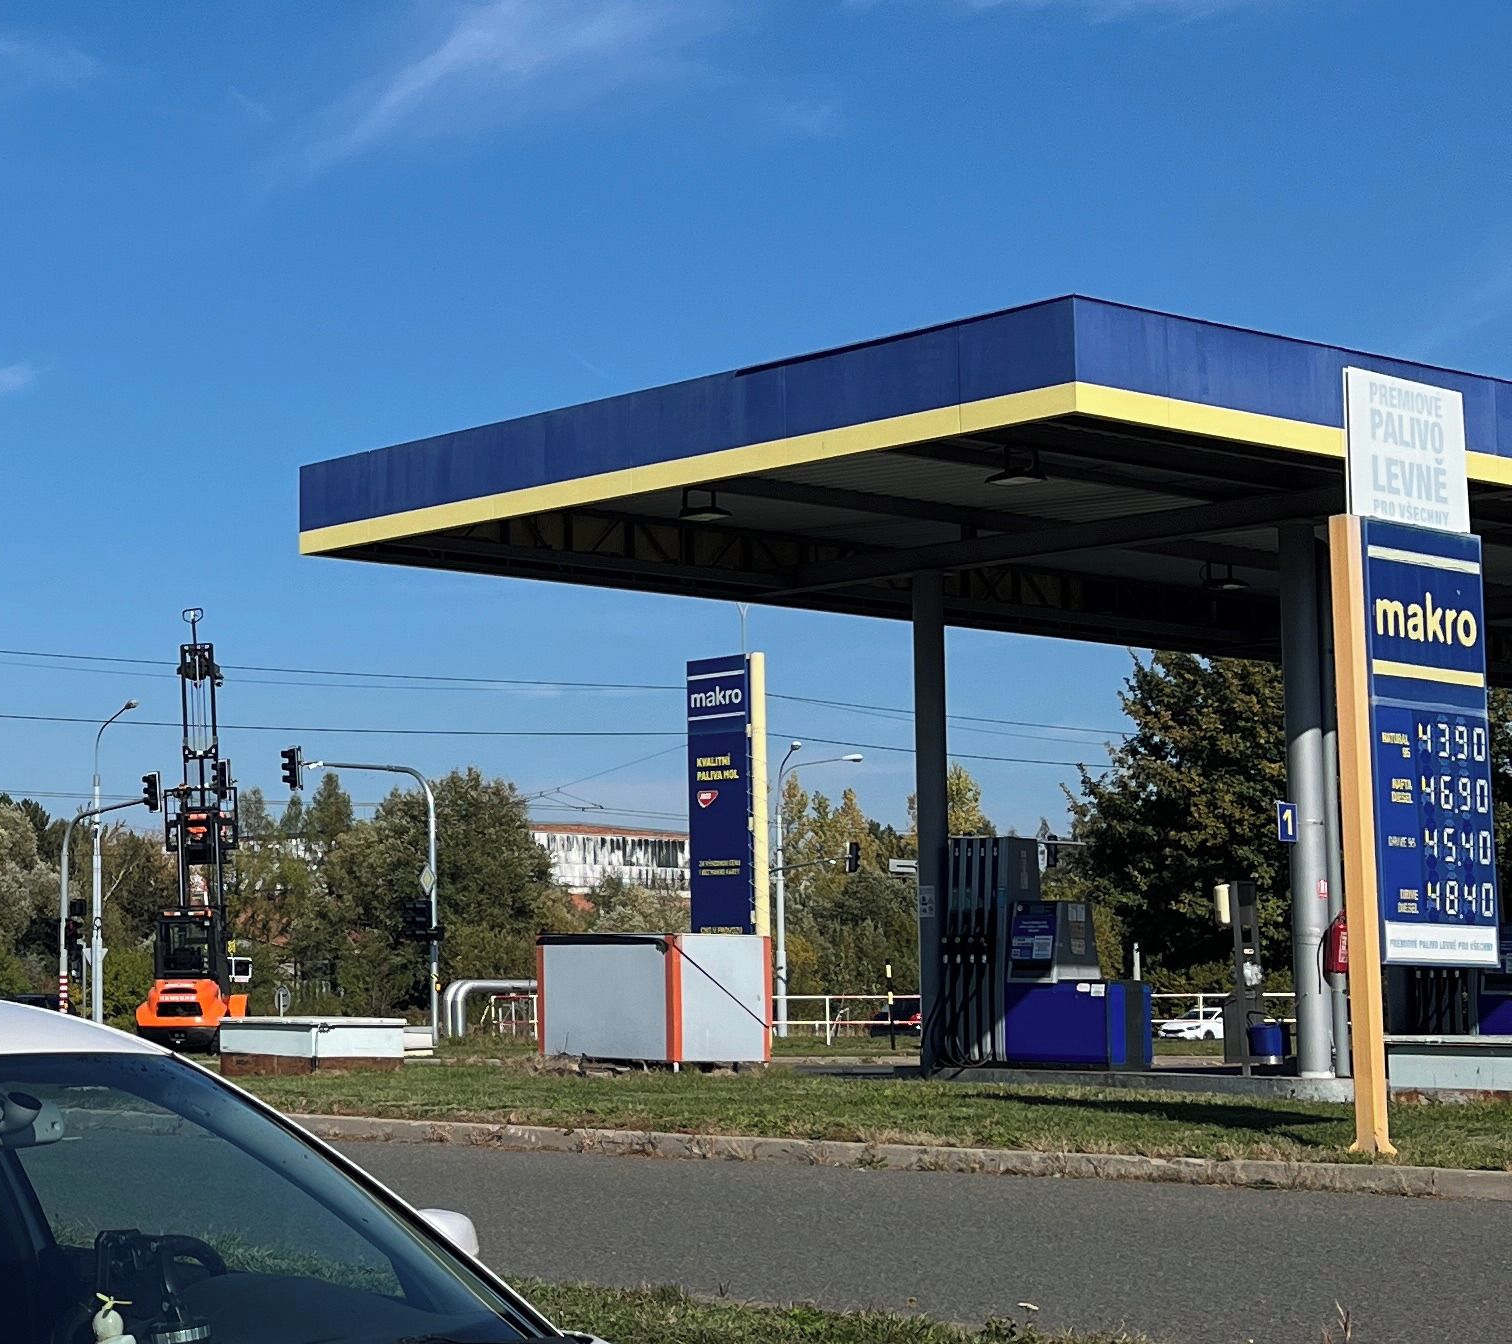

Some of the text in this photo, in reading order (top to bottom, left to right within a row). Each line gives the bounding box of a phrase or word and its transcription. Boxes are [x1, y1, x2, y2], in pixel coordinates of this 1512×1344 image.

[1369, 381, 1443, 419] PRÉMIOVÉ
[1370, 408, 1445, 454] PALIVO
[1371, 454, 1448, 505] LEVNĚ
[1373, 499, 1450, 527] PRO VŠECHNY
[1376, 592, 1477, 647] makro
[691, 686, 742, 708] makro
[696, 753, 731, 767] KVALITNÍ
[1418, 722, 1486, 762] 43.90
[696, 769, 739, 782] PALIVA MOL
[1421, 775, 1488, 813] 46.90
[1283, 809, 1293, 835] 1
[1425, 828, 1491, 866] 45.40
[1428, 881, 1494, 919] 48.40
